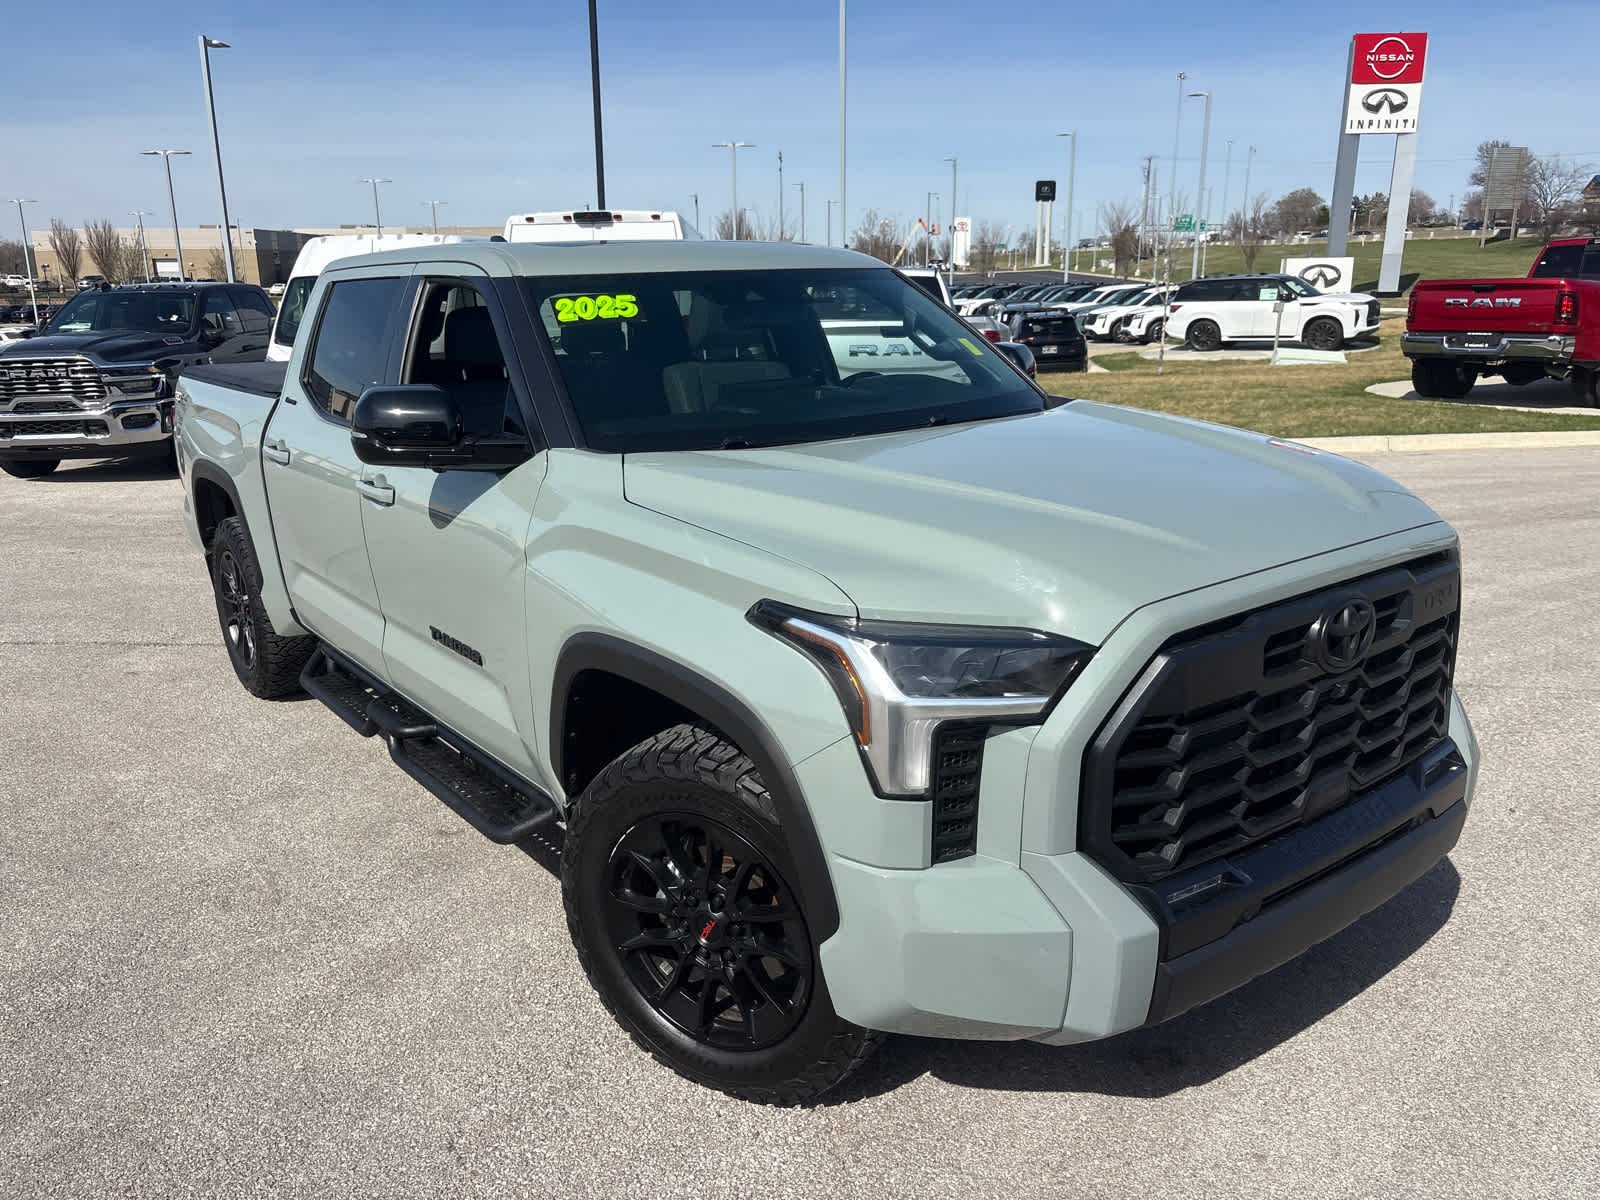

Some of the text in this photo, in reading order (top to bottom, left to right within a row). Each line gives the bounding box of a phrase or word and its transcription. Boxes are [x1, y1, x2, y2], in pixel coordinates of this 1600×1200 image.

[1366, 54, 1415, 62] NISSAN
[1350, 119, 1416, 129] INFINITI
[555, 294, 639, 322] 2025
[1445, 298, 1521, 308] RAM
